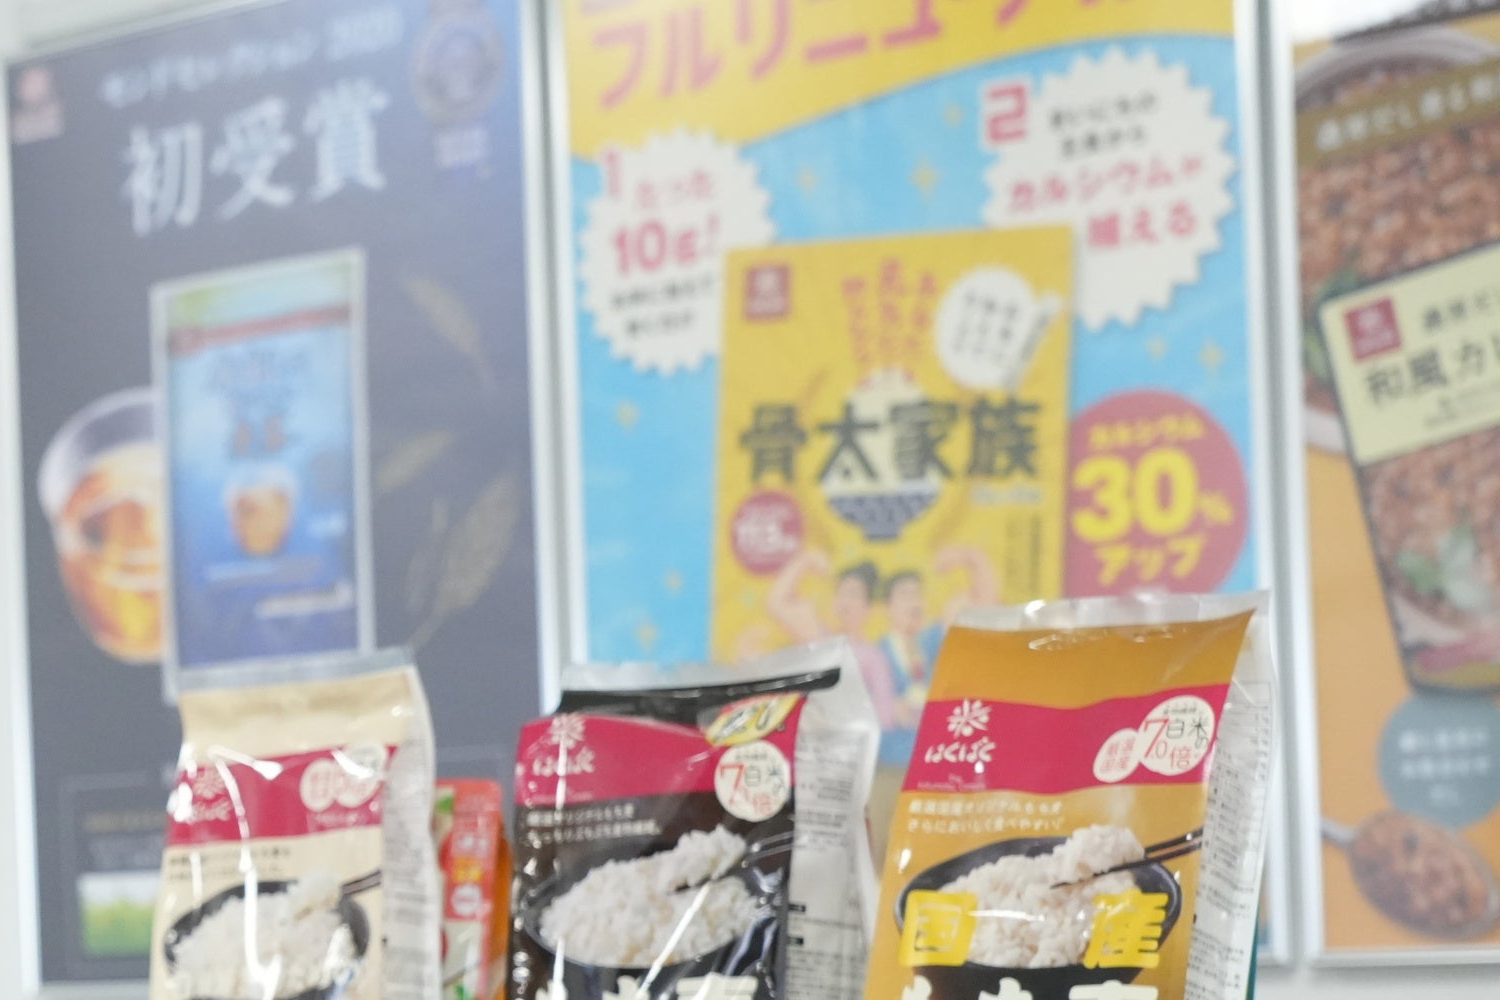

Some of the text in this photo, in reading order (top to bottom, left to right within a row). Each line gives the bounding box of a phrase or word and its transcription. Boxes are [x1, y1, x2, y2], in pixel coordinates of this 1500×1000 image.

[988, 83, 1029, 142] 2
[121, 80, 391, 237] 初受賞
[740, 397, 1041, 485] 骨太家族
[924, 736, 997, 764] はくばく
[900, 889, 1170, 969] 国産
